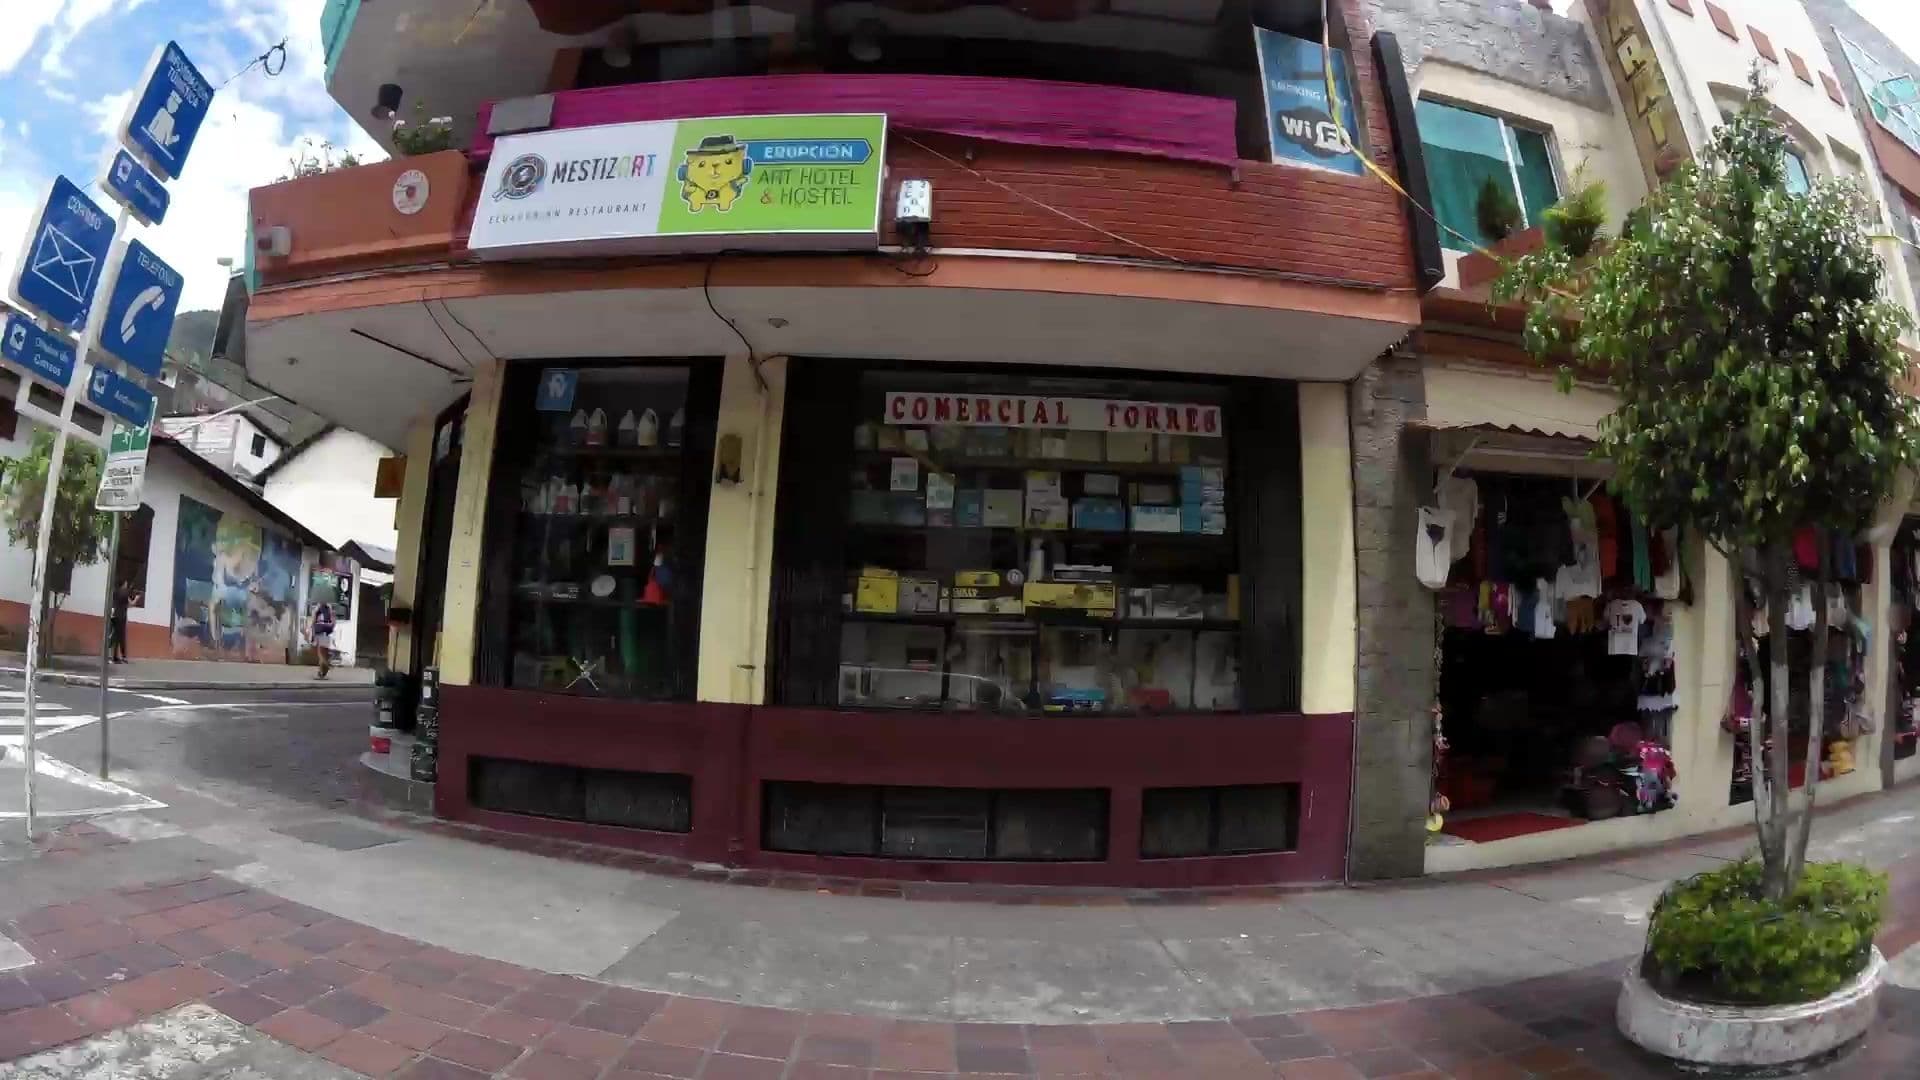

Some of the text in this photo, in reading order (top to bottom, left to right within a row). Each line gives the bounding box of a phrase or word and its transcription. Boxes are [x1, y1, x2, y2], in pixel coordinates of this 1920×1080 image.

[551, 153, 657, 185] MESTIZART
[757, 167, 861, 185] ART HOTEL
[760, 186, 853, 205] & HOSTEL
[568, 202, 648, 217] RESTAURANT
[891, 395, 1070, 425] COMERCIAL
